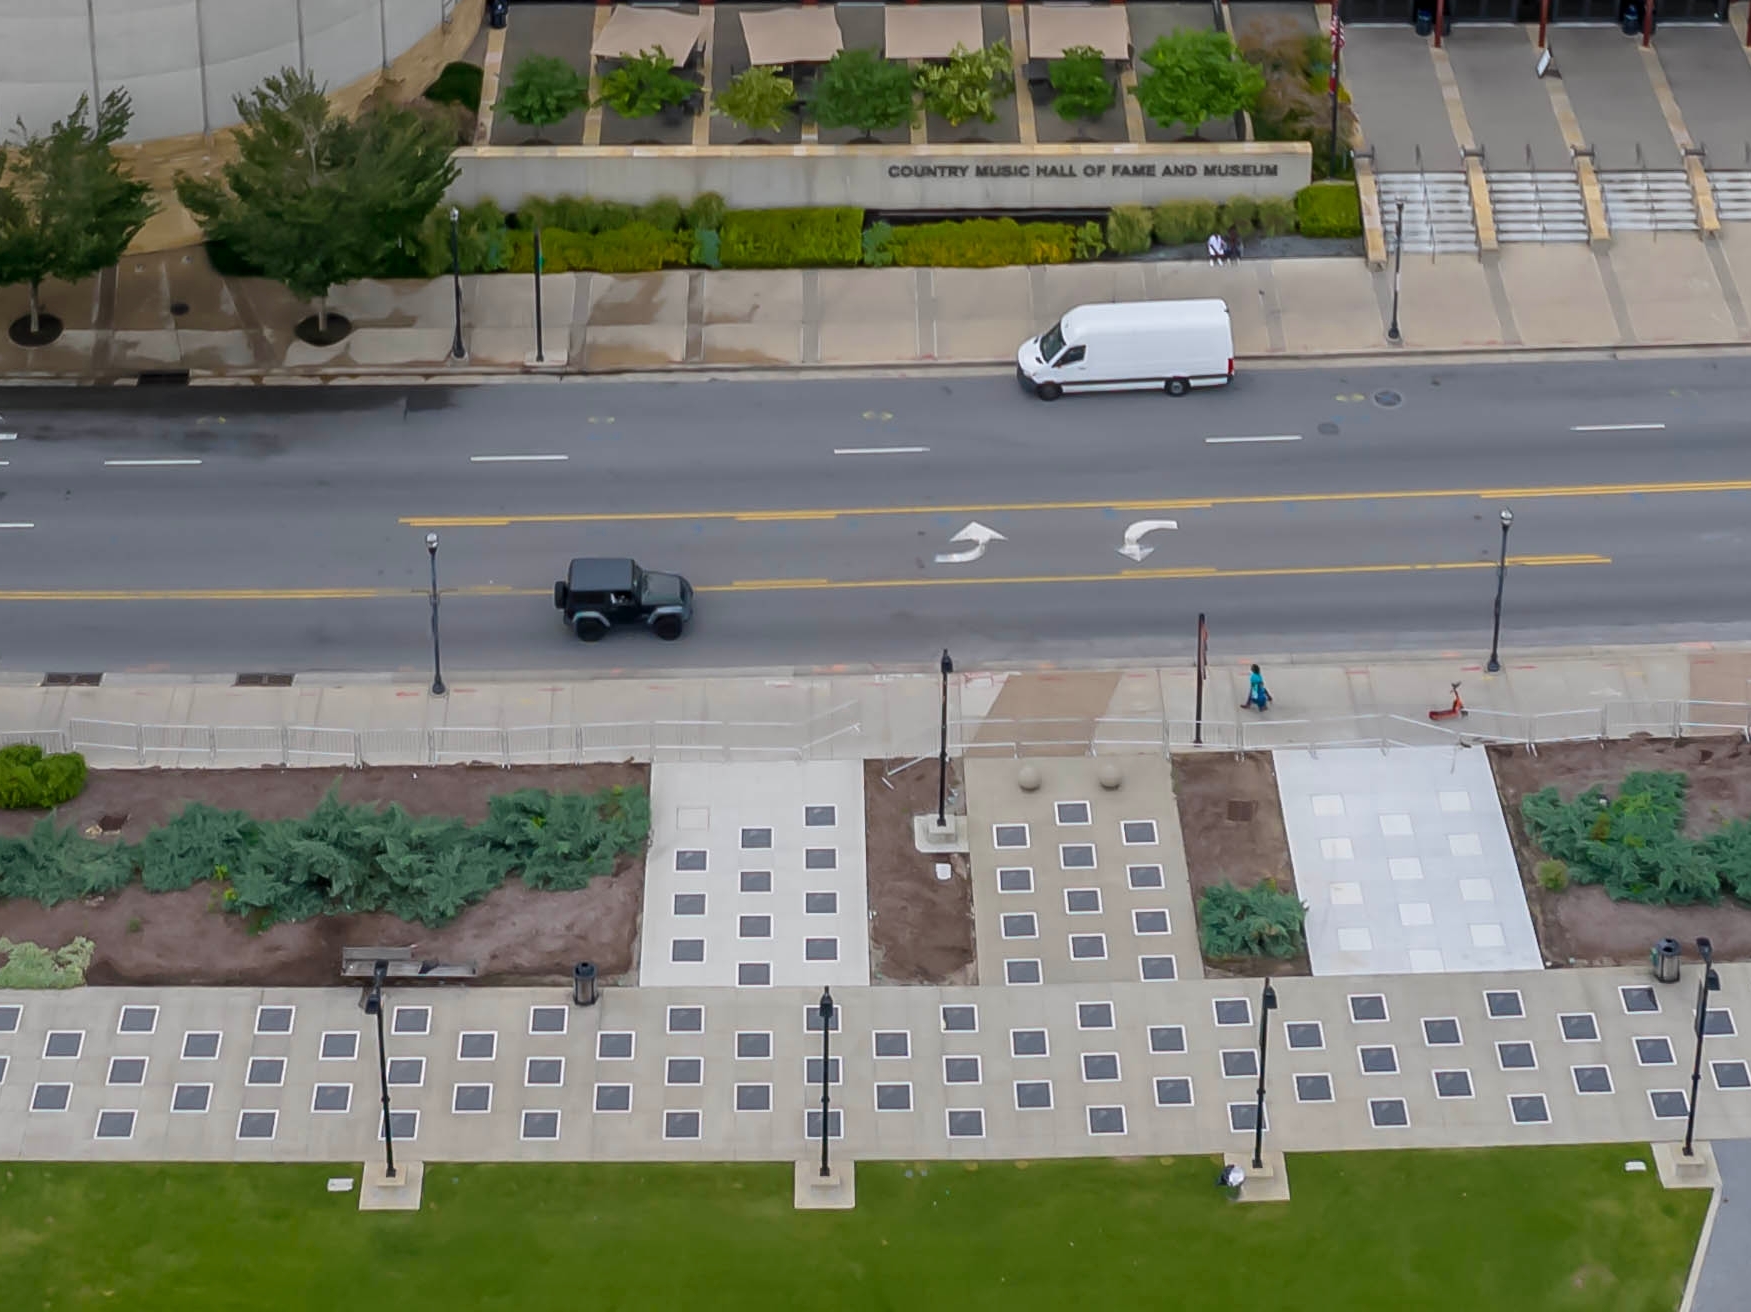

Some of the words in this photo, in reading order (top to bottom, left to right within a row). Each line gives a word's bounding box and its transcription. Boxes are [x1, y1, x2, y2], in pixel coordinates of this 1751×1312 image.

[888, 164, 969, 178] COUNTRY
[975, 164, 1031, 178] MUSIC
[1036, 164, 1077, 177] HALL
[1083, 164, 1106, 177] OF
[1111, 164, 1156, 177] FAME
[1161, 163, 1198, 177] AND
[1202, 163, 1279, 177] MUSEUM
